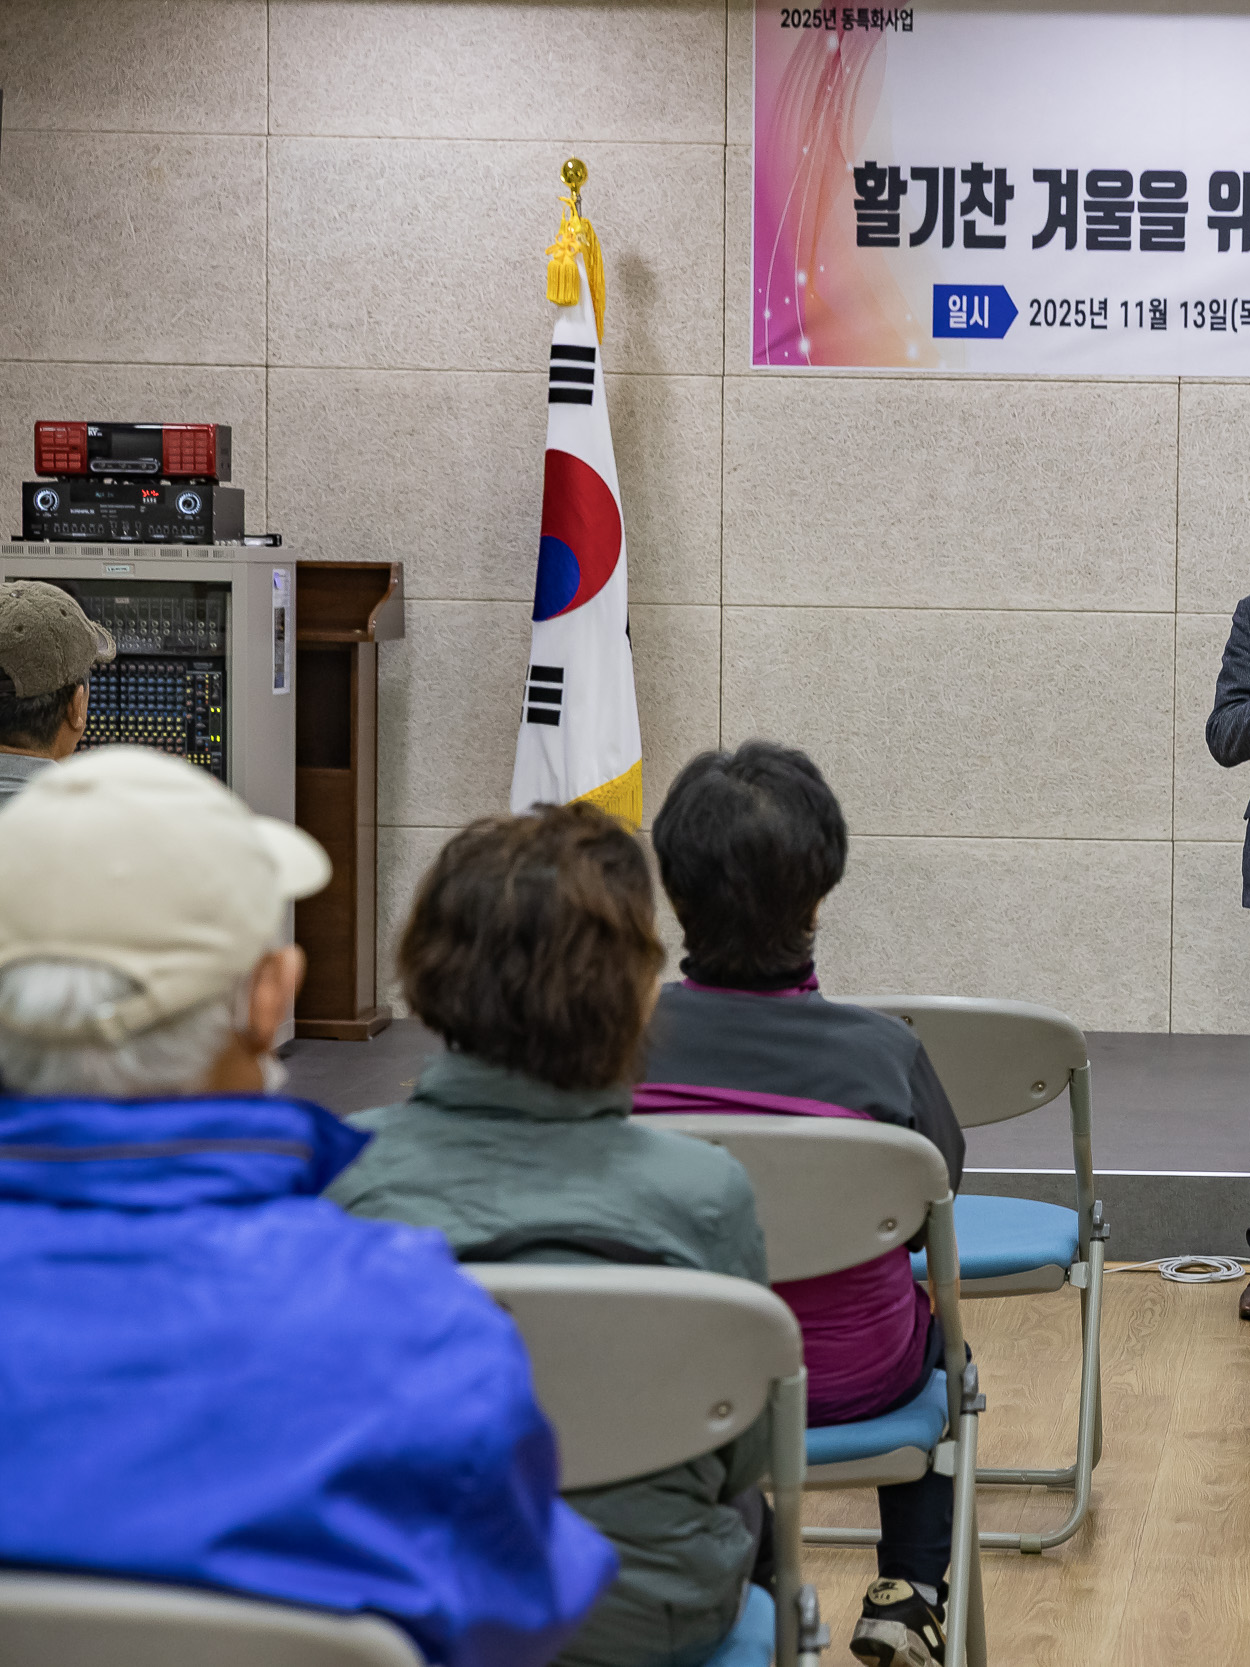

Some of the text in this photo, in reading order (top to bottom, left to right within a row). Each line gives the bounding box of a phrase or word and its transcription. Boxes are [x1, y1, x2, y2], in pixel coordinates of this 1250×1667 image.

[780, 7, 914, 32] 2025년 동특화사업
[853, 161, 1014, 249] 활기찬
[1032, 168, 1188, 251] 겨울을
[948, 294, 991, 329] 일시
[1029, 297, 1109, 330] 2025년
[1120, 297, 1168, 331] 11월
